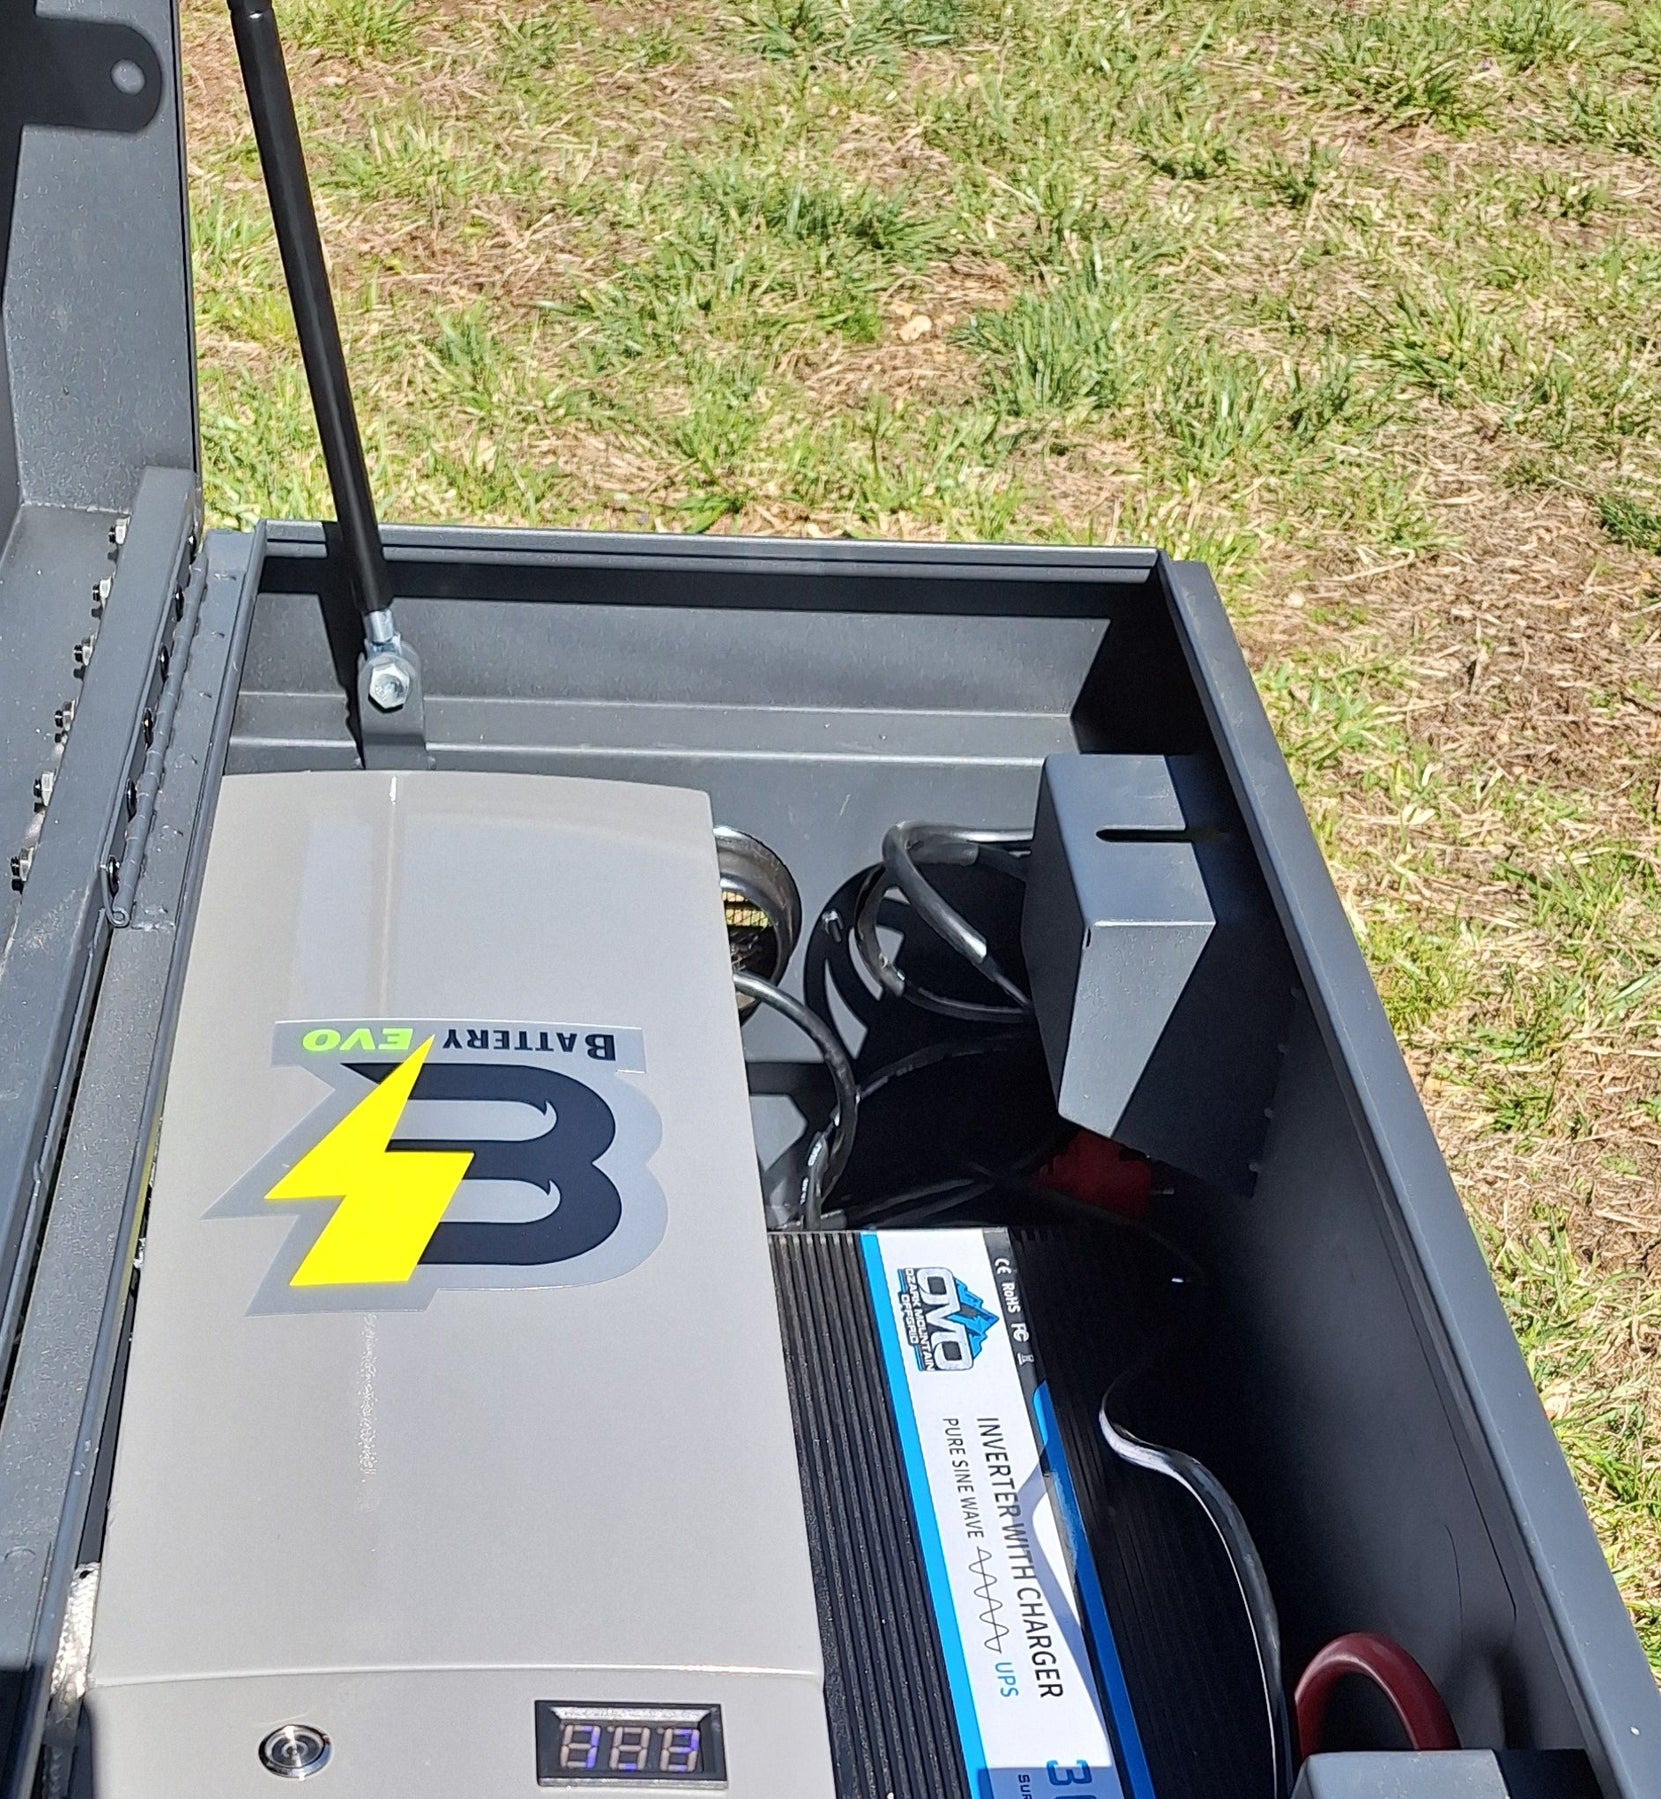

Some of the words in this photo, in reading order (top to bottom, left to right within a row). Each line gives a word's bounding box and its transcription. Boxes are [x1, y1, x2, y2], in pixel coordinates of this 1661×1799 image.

[302, 1026, 414, 1052] EVO
[442, 1028, 617, 1062] BATTERY
[1002, 1281, 1021, 1314] RoHS
[904, 1268, 922, 1310] OZARK
[914, 1308, 936, 1371] MOUNTAIN
[943, 1417, 966, 1456] PURE
[951, 1459, 974, 1493] SINE
[977, 1417, 1022, 1520] INVERTER
[960, 1496, 985, 1539] WAVE
[1002, 1522, 1036, 1580] WITH
[1017, 1586, 1064, 1698] CHARGER
[994, 1662, 1019, 1698] UPS
